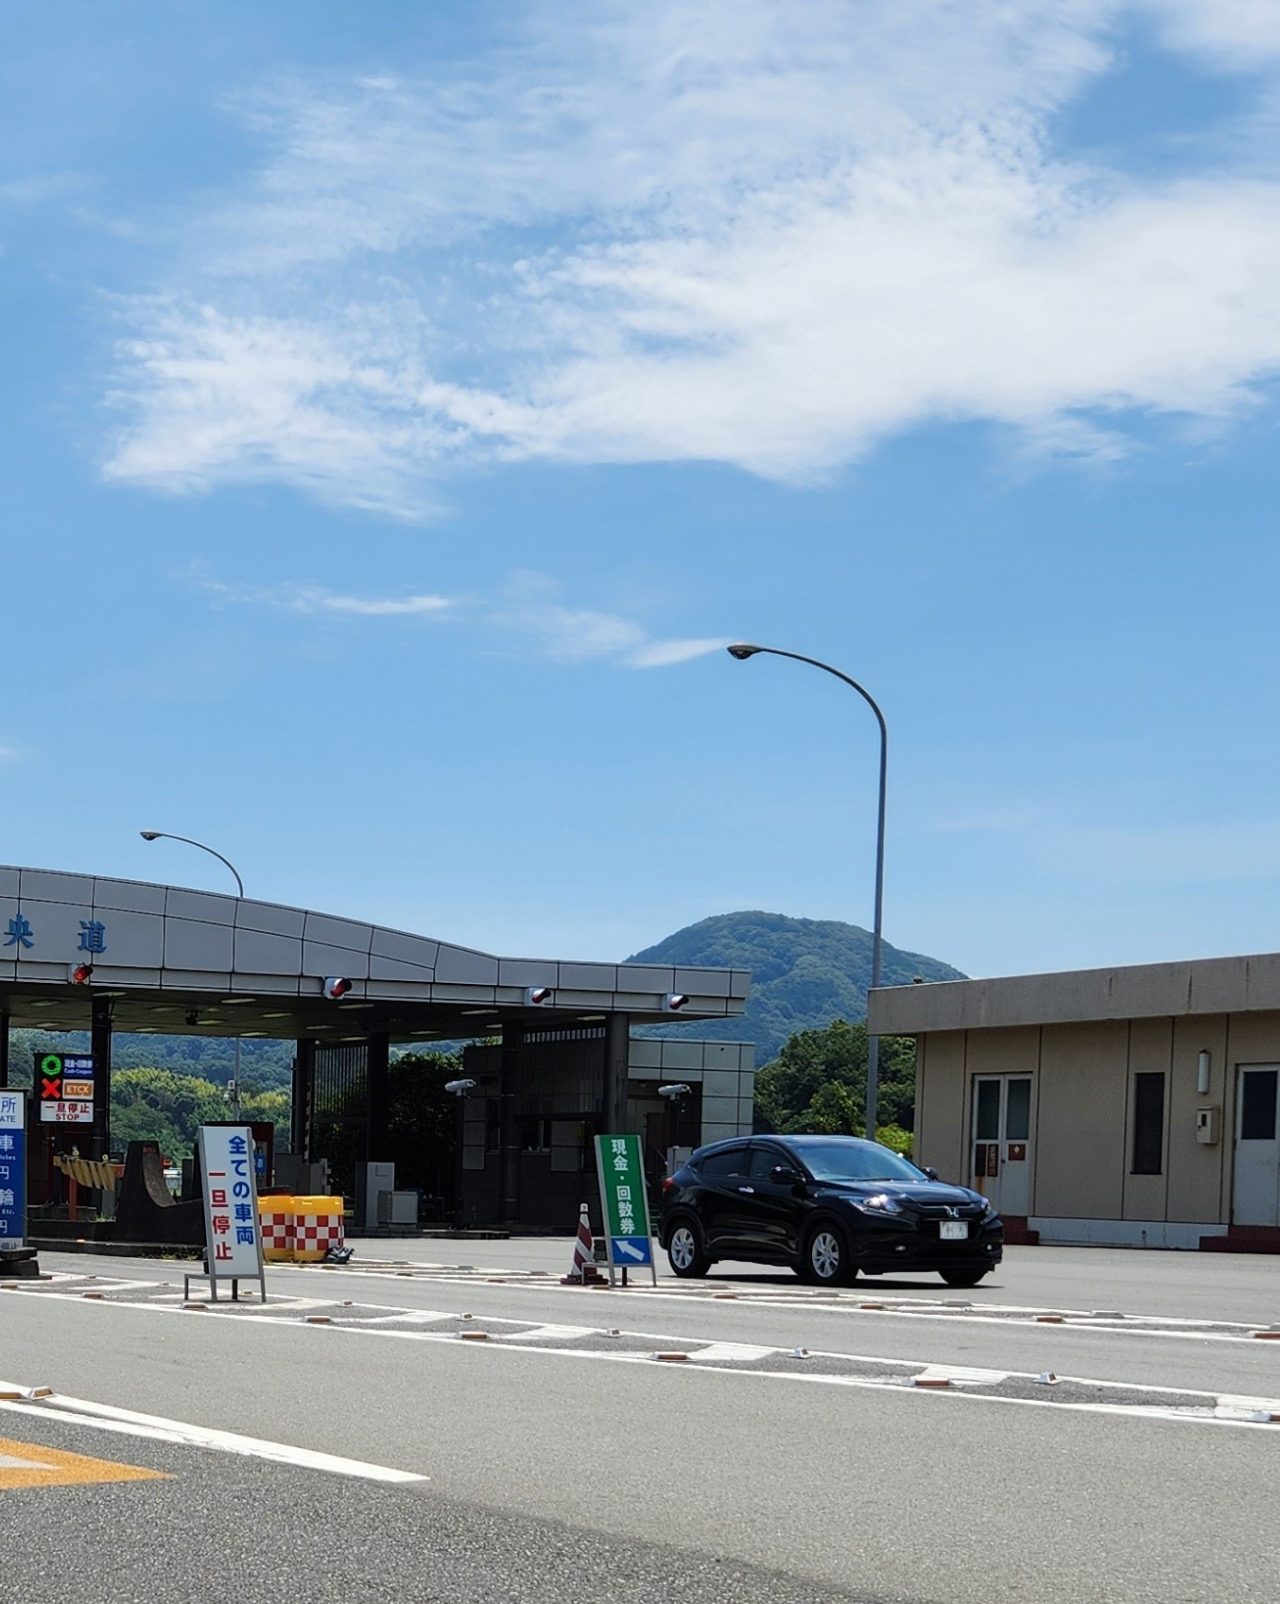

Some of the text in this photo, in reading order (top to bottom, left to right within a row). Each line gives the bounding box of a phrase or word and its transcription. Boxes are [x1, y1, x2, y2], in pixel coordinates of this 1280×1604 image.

[45, 1103, 90, 1113] 一旦停止
[66, 1085, 89, 1095] ETCX
[208, 1172, 233, 1260] 一旦停止
[228, 1135, 254, 1245] 全ての車両
[611, 1139, 635, 1234] 現金・回数券
